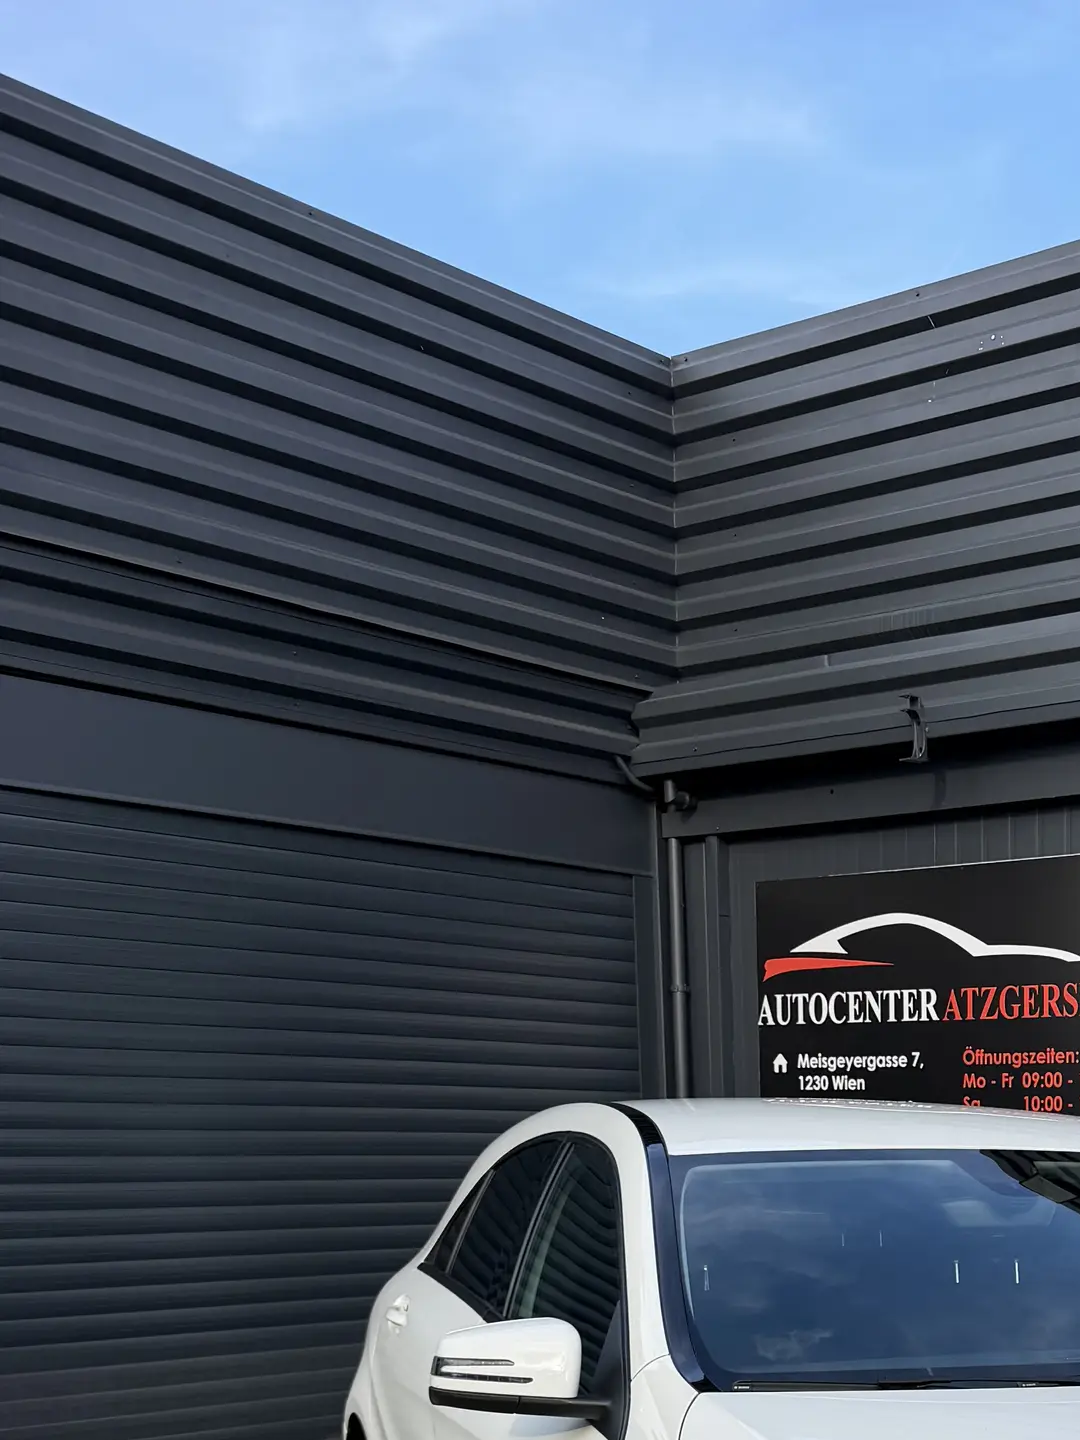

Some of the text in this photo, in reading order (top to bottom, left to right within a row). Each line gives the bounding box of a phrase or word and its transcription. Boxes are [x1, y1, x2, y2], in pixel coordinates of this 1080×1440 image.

[757, 987, 940, 1026] AUTOCENTER
[797, 1051, 925, 1072] Meisgeyergasse 7,
[963, 1046, 1080, 1068] Öffnungszeiten:
[798, 1074, 866, 1091] 1230 Wien
[963, 1073, 986, 1088] Mo
[1001, 1073, 1014, 1088] Fr
[1022, 1072, 1063, 1088] 09:00
[1023, 1095, 1063, 1111] 10:00
